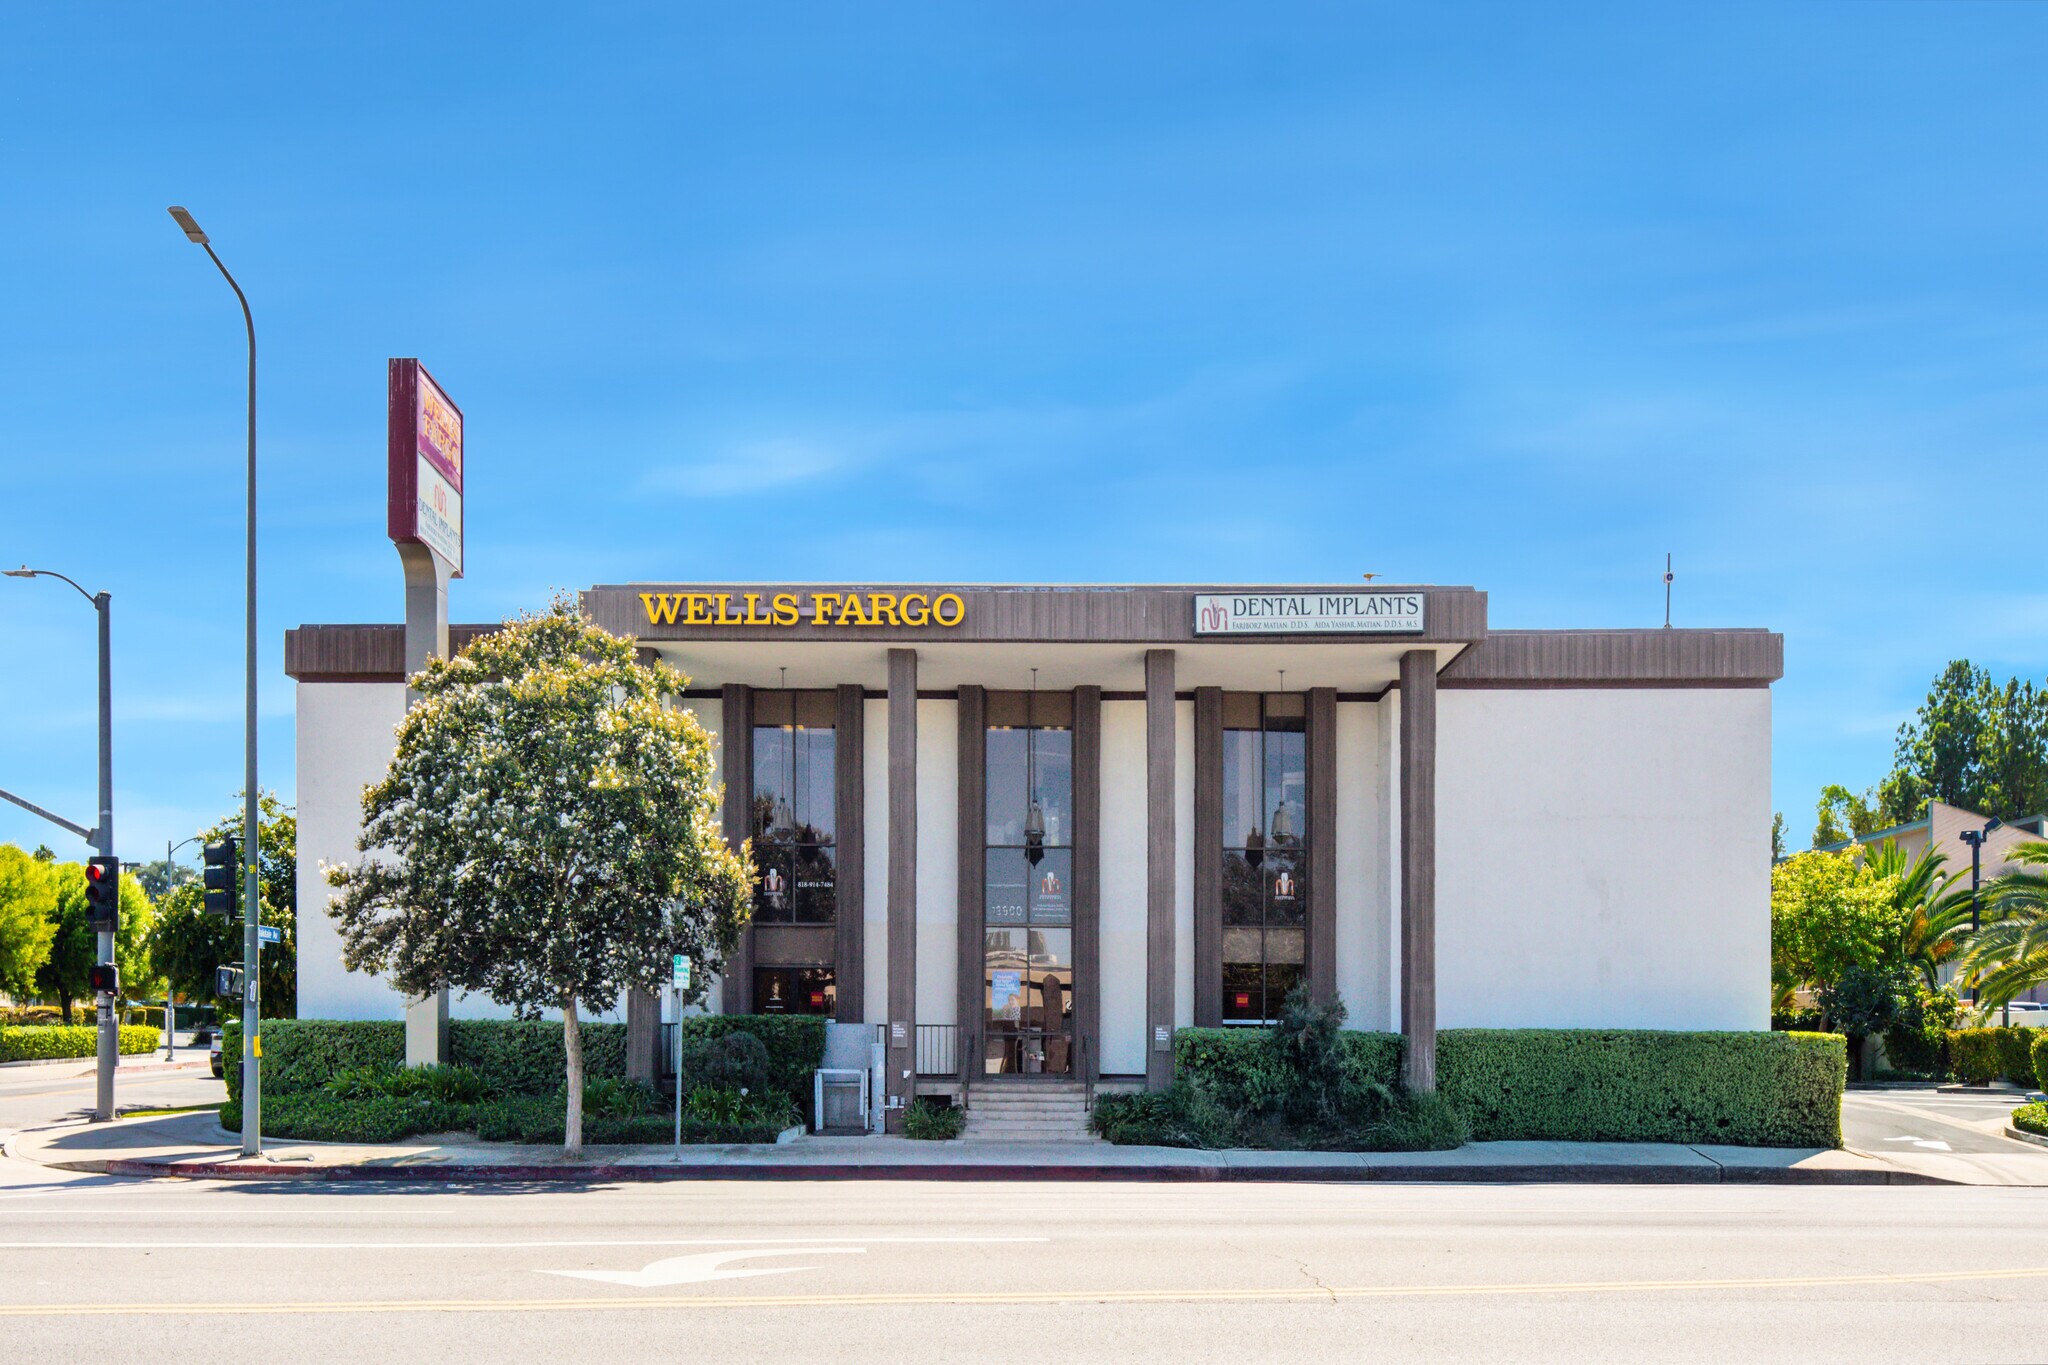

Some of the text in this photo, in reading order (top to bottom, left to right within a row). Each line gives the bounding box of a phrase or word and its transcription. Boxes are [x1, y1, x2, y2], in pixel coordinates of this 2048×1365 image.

[423, 388, 459, 447] WELLS
[423, 413, 459, 469] FARGO
[418, 497, 438, 527] DENTAL
[438, 516, 461, 548] IMPLANTS
[638, 593, 966, 626] WELLS FARGO
[1233, 596, 1419, 616] DENTAL IMPLANTS
[1314, 620, 1331, 629] AIDA
